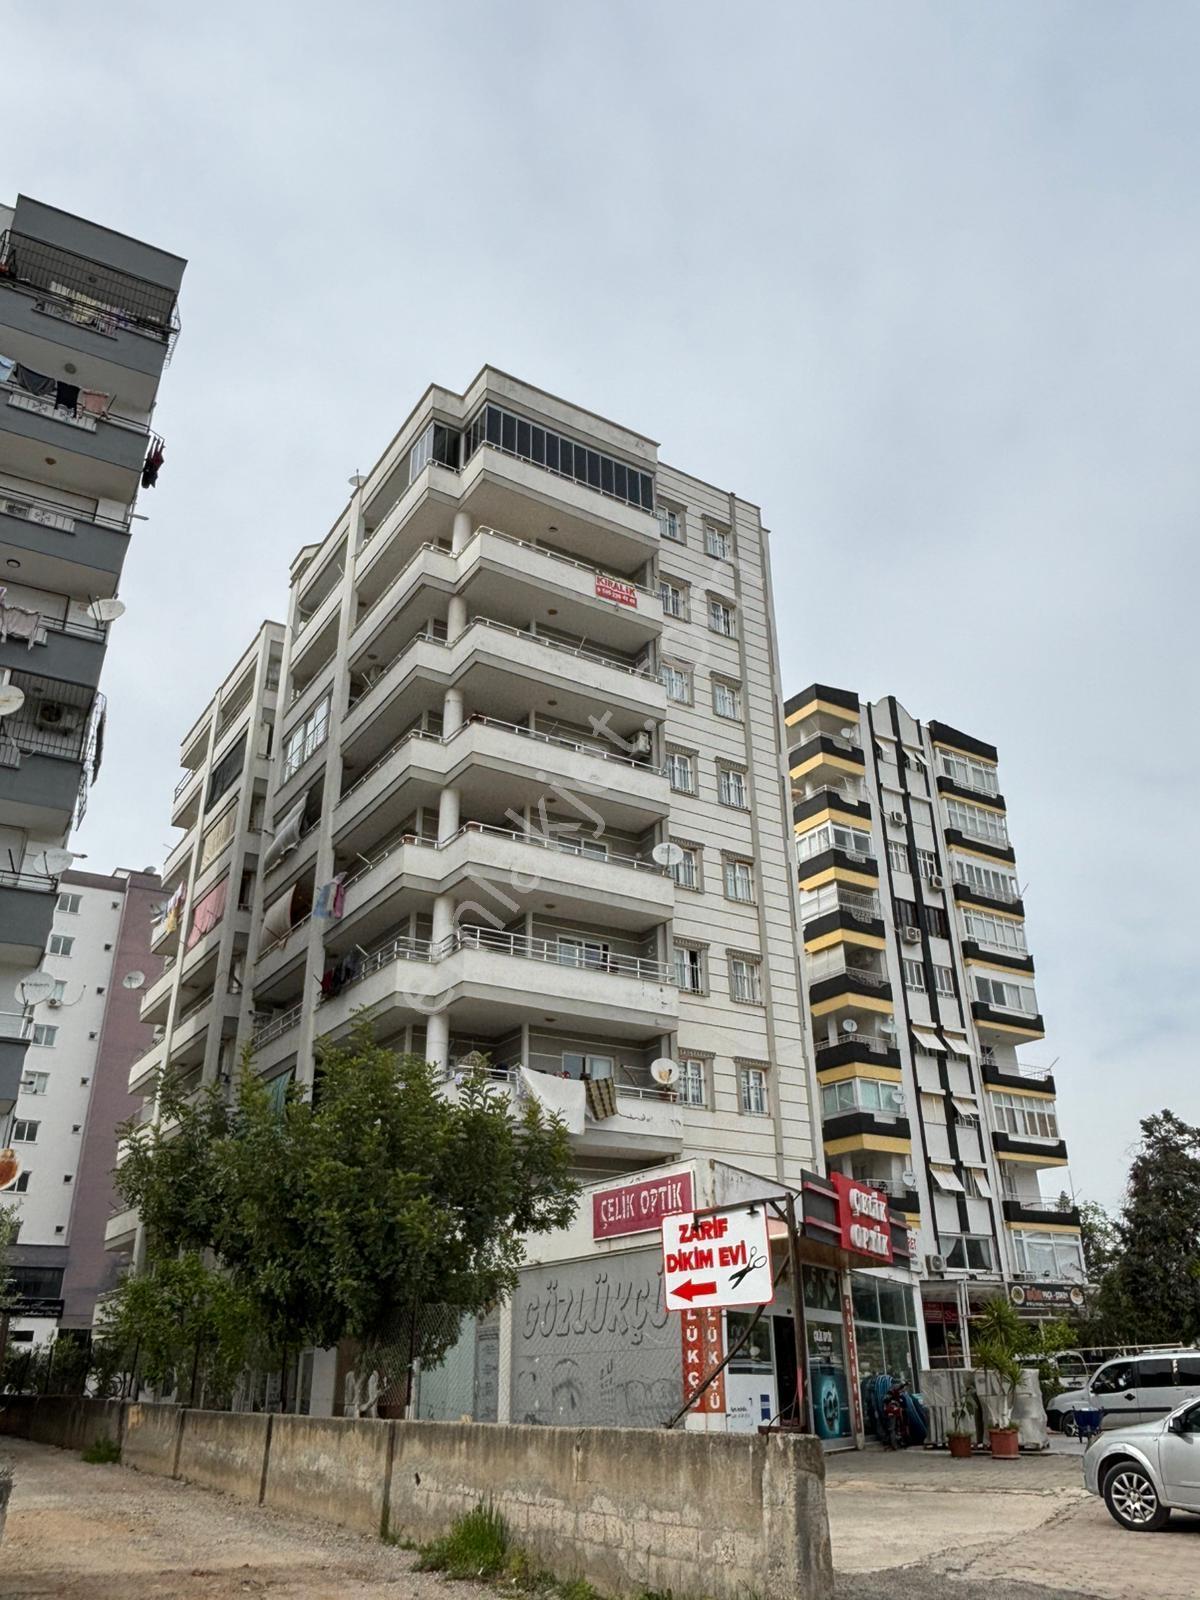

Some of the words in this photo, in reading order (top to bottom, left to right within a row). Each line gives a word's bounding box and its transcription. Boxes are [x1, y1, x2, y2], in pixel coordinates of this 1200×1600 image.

[600, 1190, 635, 1230] ÇELİK
[640, 1180, 683, 1214] OPTİK
[849, 1188, 888, 1222] ÇELİK
[678, 1215, 729, 1244] ZARİF
[850, 1223, 890, 1256] OPTİK
[666, 1246, 714, 1273] DİKİM
[718, 1240, 748, 1267] EVİ
